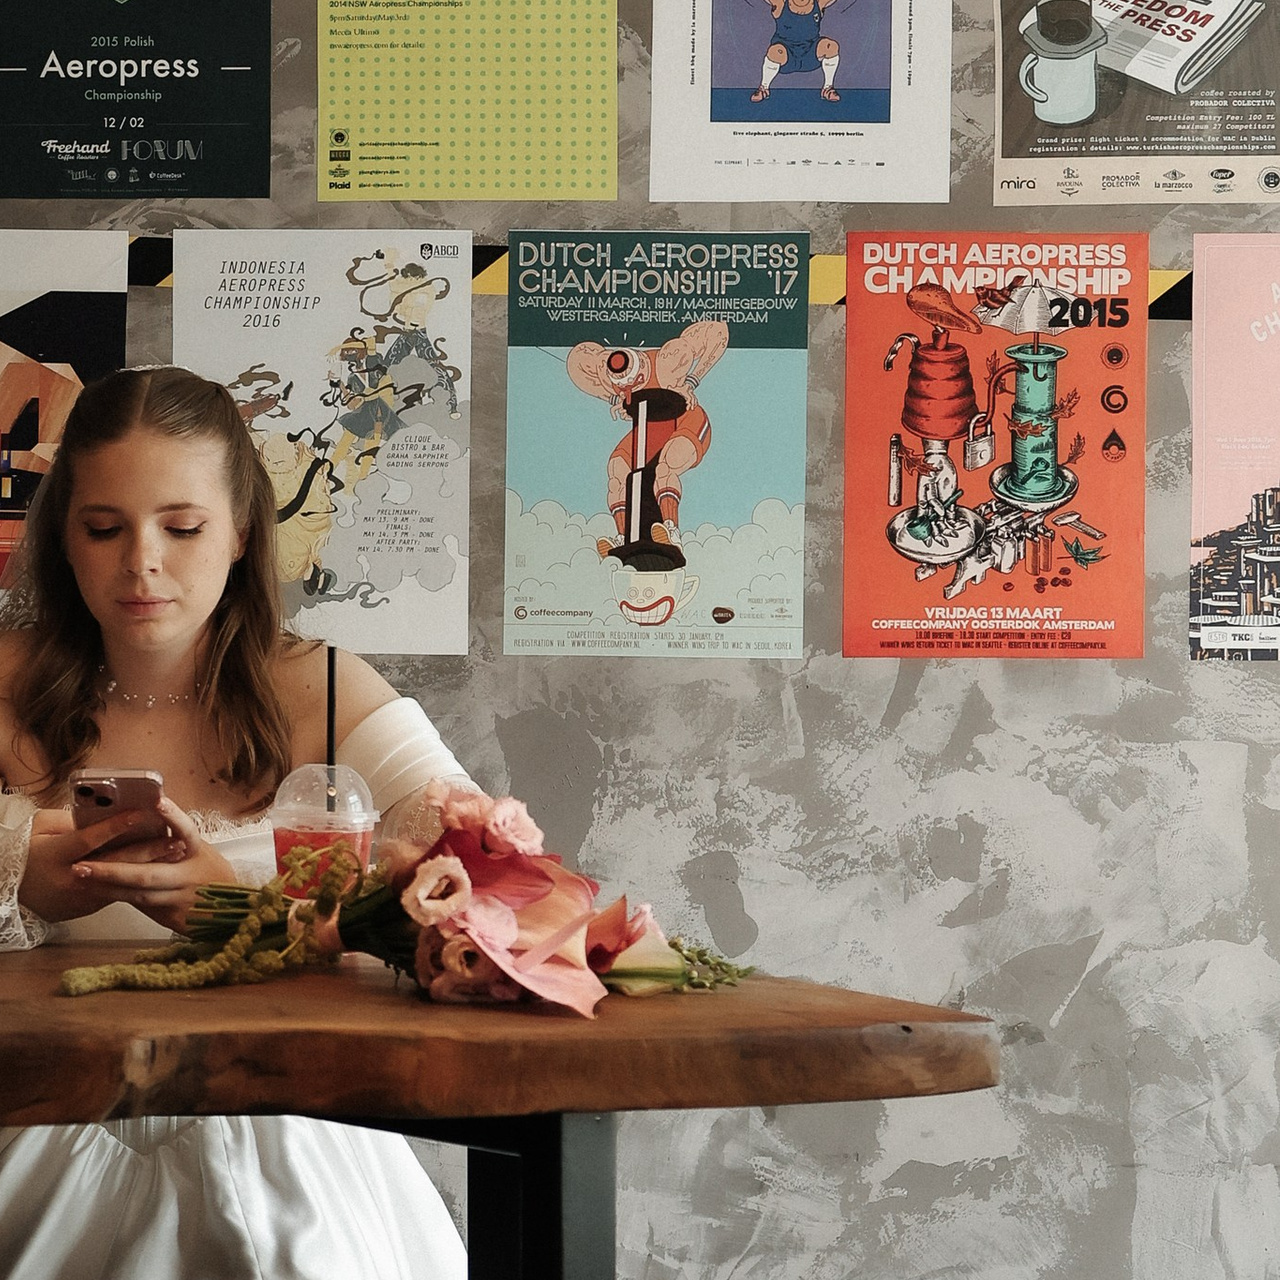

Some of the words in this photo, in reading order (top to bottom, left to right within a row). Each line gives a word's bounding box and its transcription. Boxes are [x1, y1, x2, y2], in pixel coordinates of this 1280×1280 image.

[407, 0, 463, 8] Championships
[1120, 9, 1197, 44] PRESS
[91, 37, 118, 47] 2015
[124, 36, 154, 47] Polish
[40, 50, 200, 86] Aeropress
[84, 90, 162, 102] Championship
[41, 140, 110, 154] Freehand
[122, 140, 203, 160] FORUM
[1001, 178, 1036, 189] mira
[433, 245, 458, 256] ABCD
[519, 242, 610, 268] DUTCH
[624, 243, 798, 268] AEROPRESS
[864, 243, 958, 264] DUTCH
[964, 243, 1126, 266] AEROPRESS
[220, 261, 305, 274] INDONESIA
[219, 279, 305, 292] AEROPRESS
[519, 269, 740, 295] CHAMPIONSHIP
[204, 297, 320, 309] CHAMPIONSHIP
[683, 298, 798, 310] MACHINEGEBOUW
[682, 312, 768, 323] AMSTERDAM
[1049, 298, 1129, 328] 2015
[243, 315, 280, 328] 2016
[530, 609, 593, 619] coffeecompany
[925, 607, 987, 620] VRIJDAG
[990, 607, 1004, 618] 13
[1006, 607, 1063, 619] MAART
[872, 620, 969, 630] COFFEECOMPANY
[972, 620, 1041, 629] OOSTERDOK
[1043, 620, 1114, 629] AMSTERDAM
